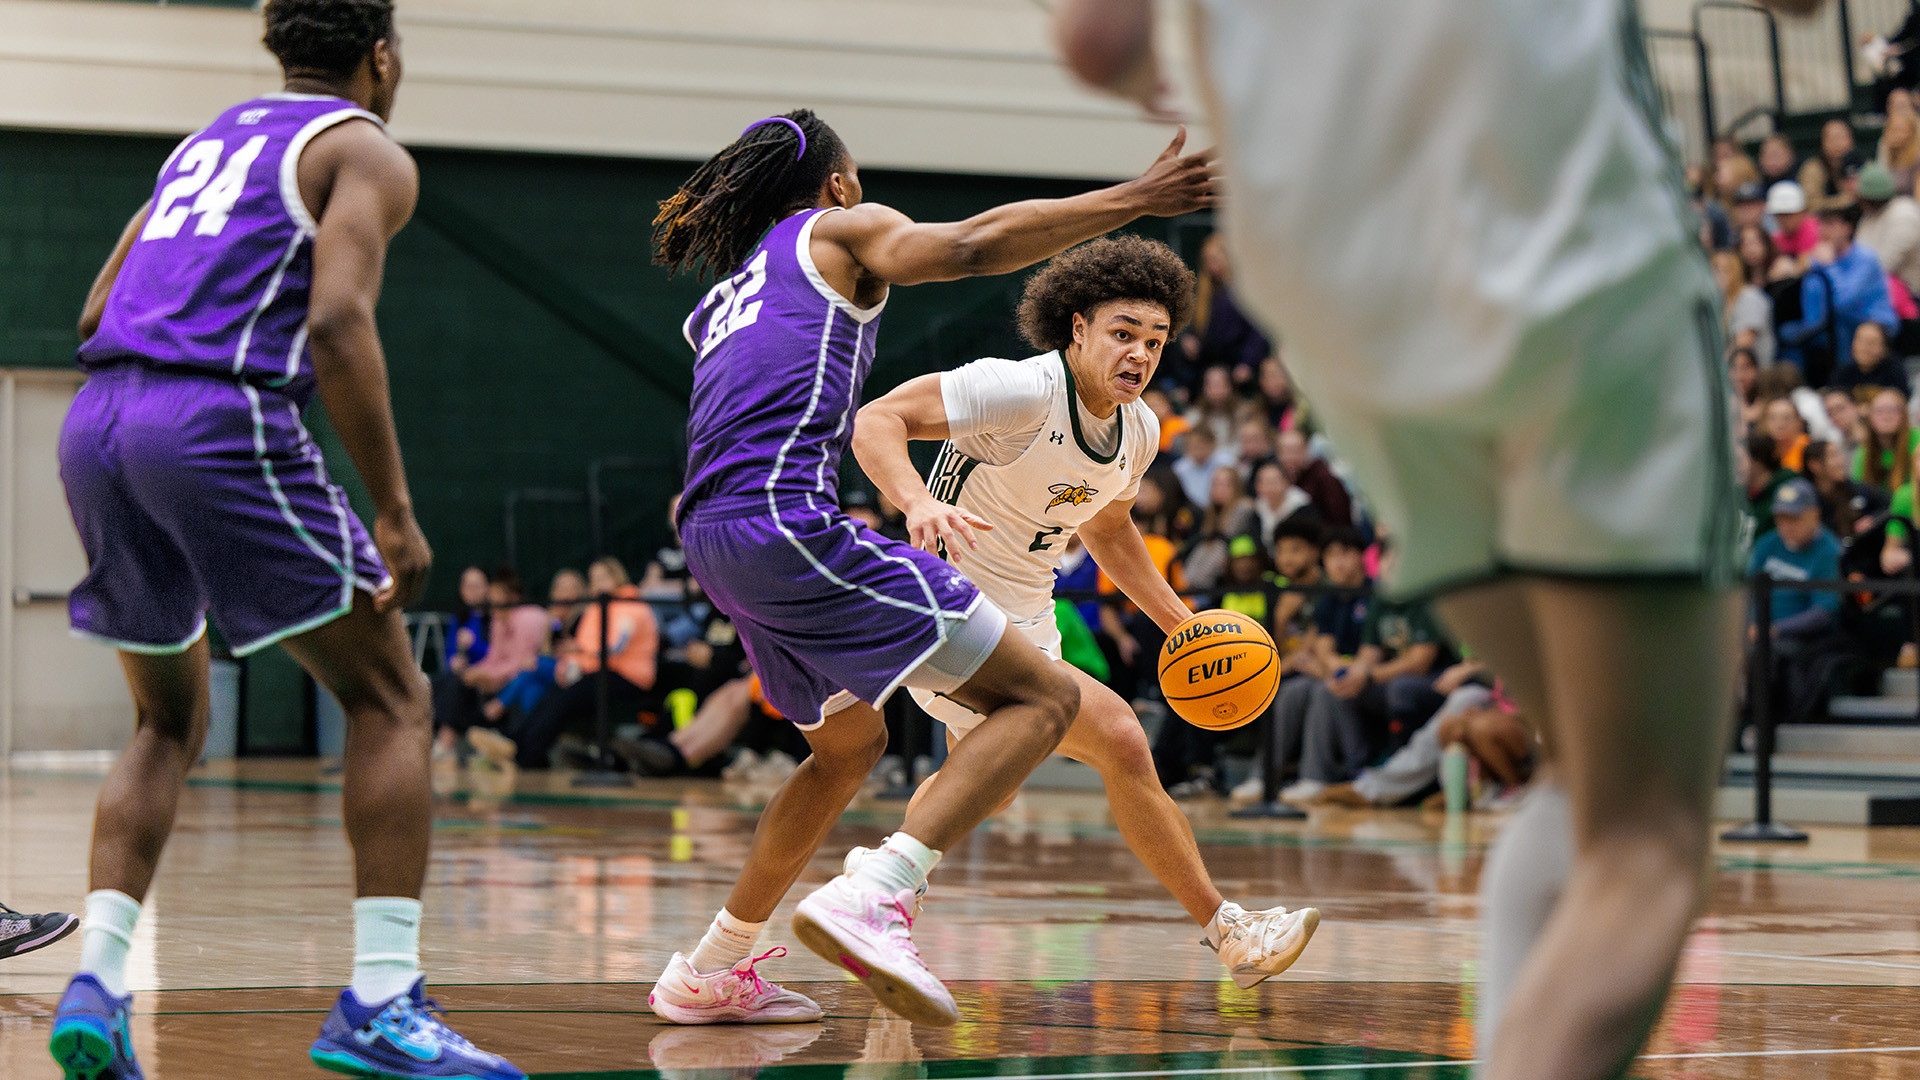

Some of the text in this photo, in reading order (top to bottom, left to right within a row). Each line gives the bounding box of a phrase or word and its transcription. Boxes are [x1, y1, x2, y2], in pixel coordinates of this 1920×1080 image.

[140, 135, 269, 242] 24
[701, 250, 768, 359] 22
[1029, 526, 1063, 552] 2
[1166, 622, 1243, 655] Wilson
[1188, 652, 1247, 684] EVO NXT
